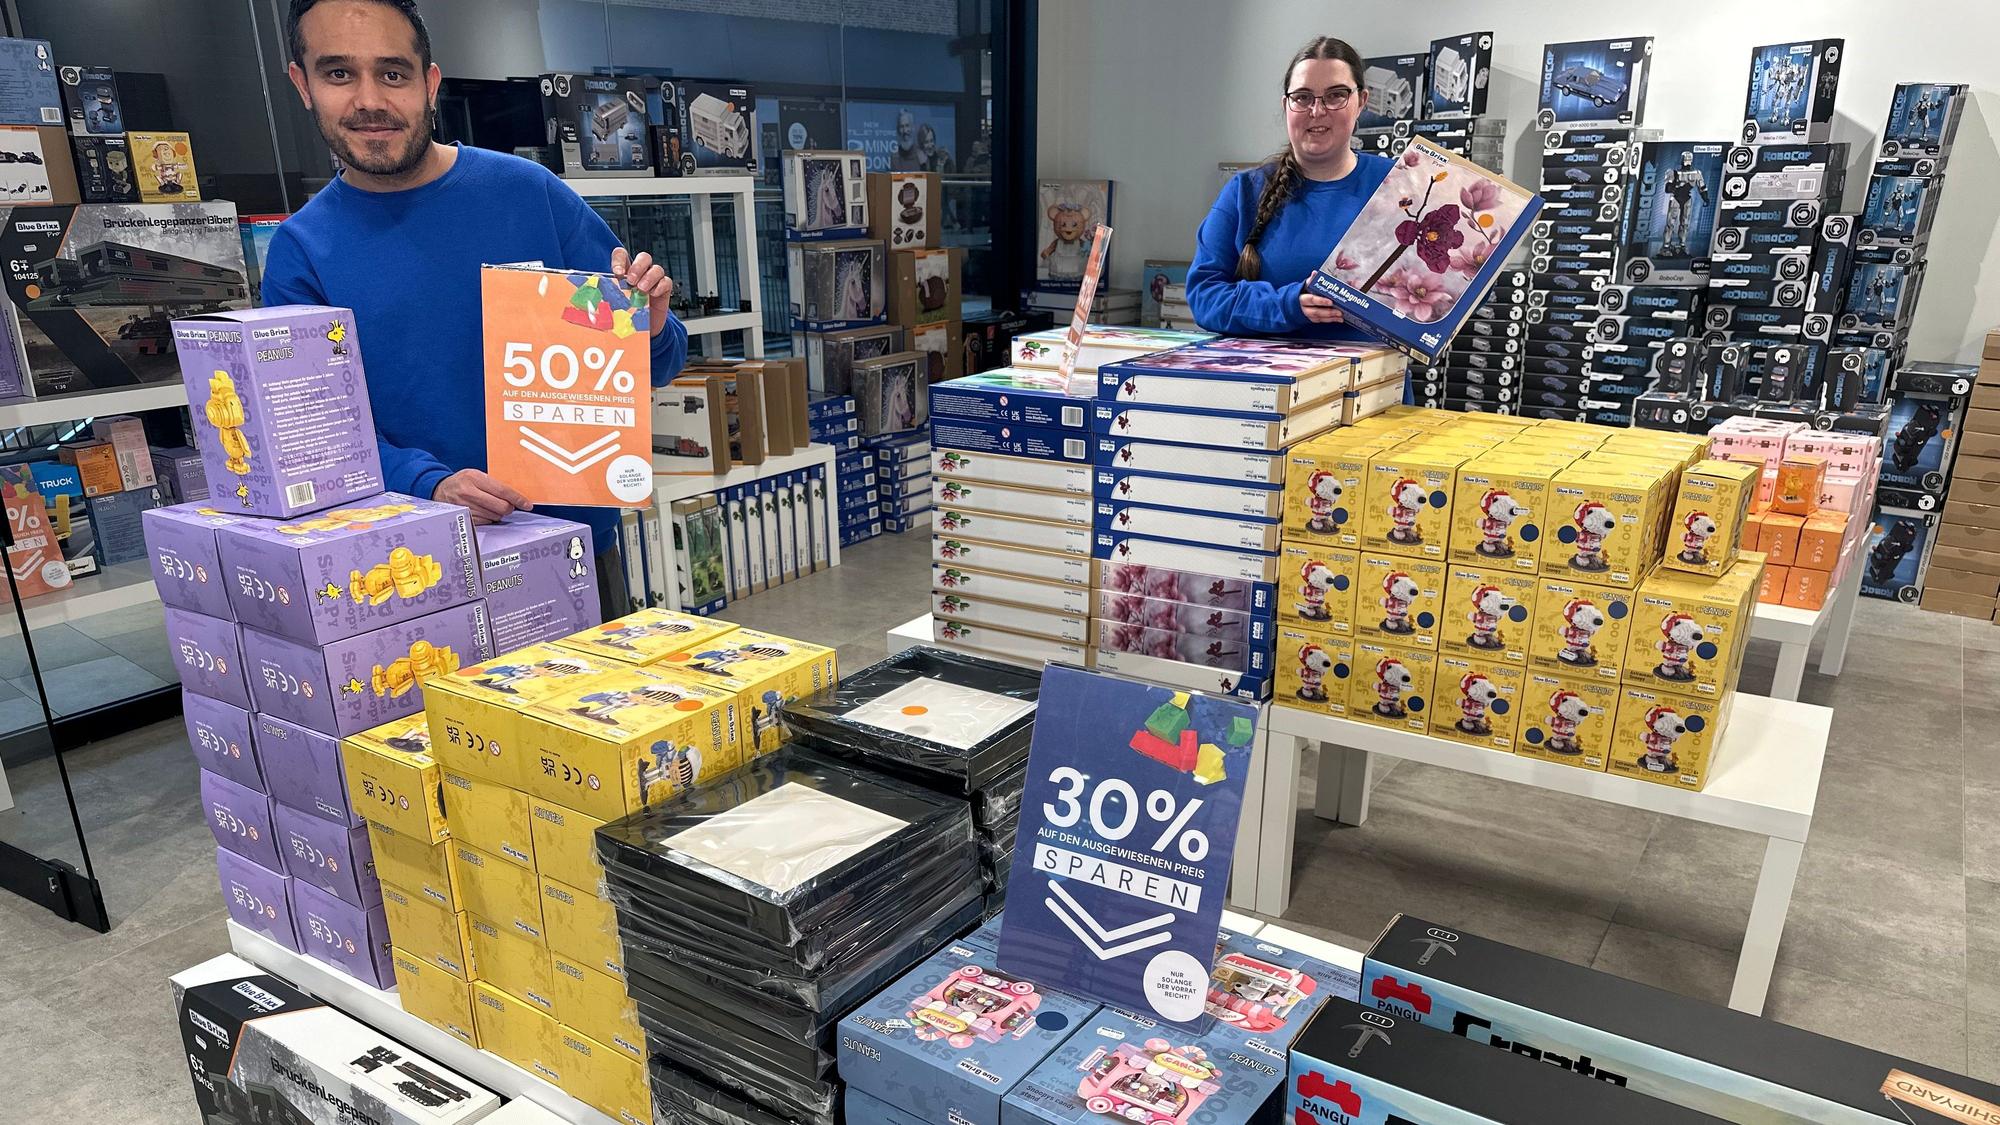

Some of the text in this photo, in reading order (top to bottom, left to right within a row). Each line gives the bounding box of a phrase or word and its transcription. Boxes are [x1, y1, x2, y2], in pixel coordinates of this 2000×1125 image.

[1415, 143, 1448, 163] Blue Brixx
[17, 221, 59, 230] Blue Brixx
[13, 272, 39, 281] 104125
[1316, 275, 1370, 309] Purple Magnolia
[177, 330, 243, 344] Blue Brixx PEANUTS
[253, 329, 289, 339] Blue Brixx
[256, 346, 294, 363] PEANUTS
[503, 342, 635, 394] 50%
[502, 390, 635, 404] AUF DEN AUSGEWIESENEN PREIS
[512, 404, 627, 425] SPAREN
[39, 477, 73, 489] TRUCK
[457, 515, 477, 598] Blue Brixx PEANUTS
[484, 554, 519, 569] Blue Brixx
[486, 574, 523, 595] PEANUTS
[475, 606, 483, 622] Blue
[477, 622, 486, 645] Brixx
[263, 722, 287, 740] PEANUTS
[711, 709, 722, 752] PEANUTS
[1043, 766, 1210, 862] 30%
[1037, 827, 1206, 879] AUF DEN AUSGEWIESENEN PREIS
[1044, 849, 1189, 907] SPAREN
[1156, 982, 1197, 994] DER VORRAT
[1161, 976, 1193, 987] SOLANGE
[236, 982, 278, 1009] Blue Brixx
[1164, 991, 1190, 1000] REICHT!
[924, 1012, 961, 1030] CANDY
[1377, 999, 1421, 1022] PANGU
[190, 1010, 228, 1042] Blue Brixx
[854, 1015, 895, 1036] PEANUTS
[843, 1036, 881, 1062] PEANUTS
[959, 1061, 1000, 1084] Blue Brixx
[1165, 1056, 1206, 1074] CANDY
[1229, 1052, 1278, 1077] PEANUTS
[1054, 1099, 1076, 1111] candy
[1302, 1098, 1350, 1125] PANGU
[1896, 1080, 2000, 1125] SHIPYARD
